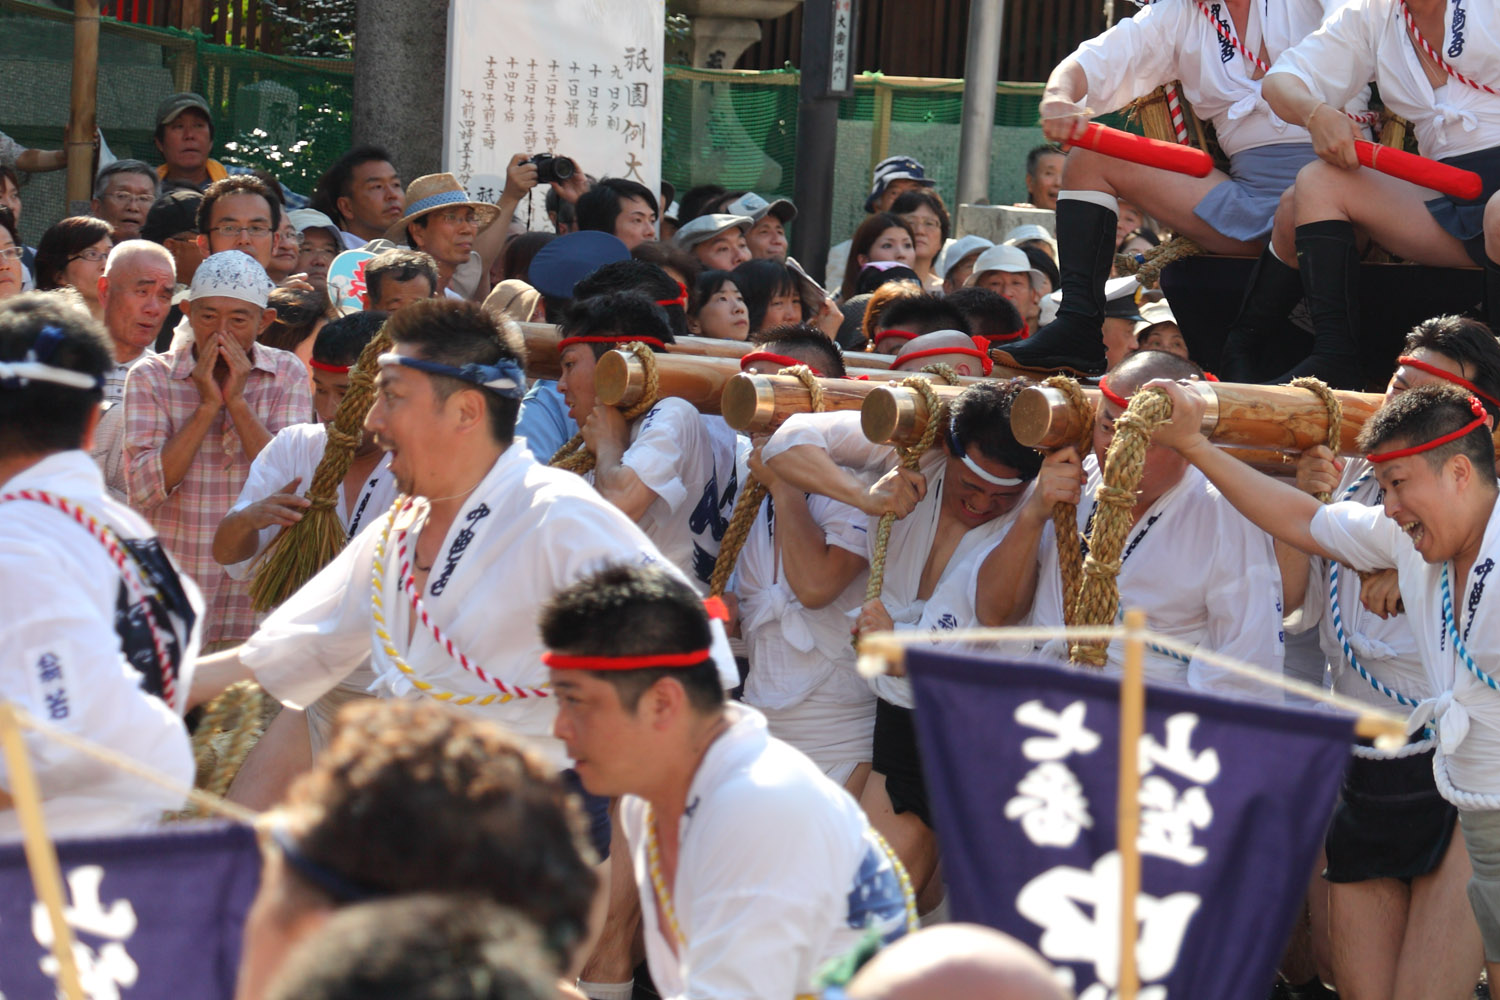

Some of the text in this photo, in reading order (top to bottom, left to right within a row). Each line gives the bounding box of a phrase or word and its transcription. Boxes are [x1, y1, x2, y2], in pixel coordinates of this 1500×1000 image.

[544, 60, 560, 154] 十二日午后三時
